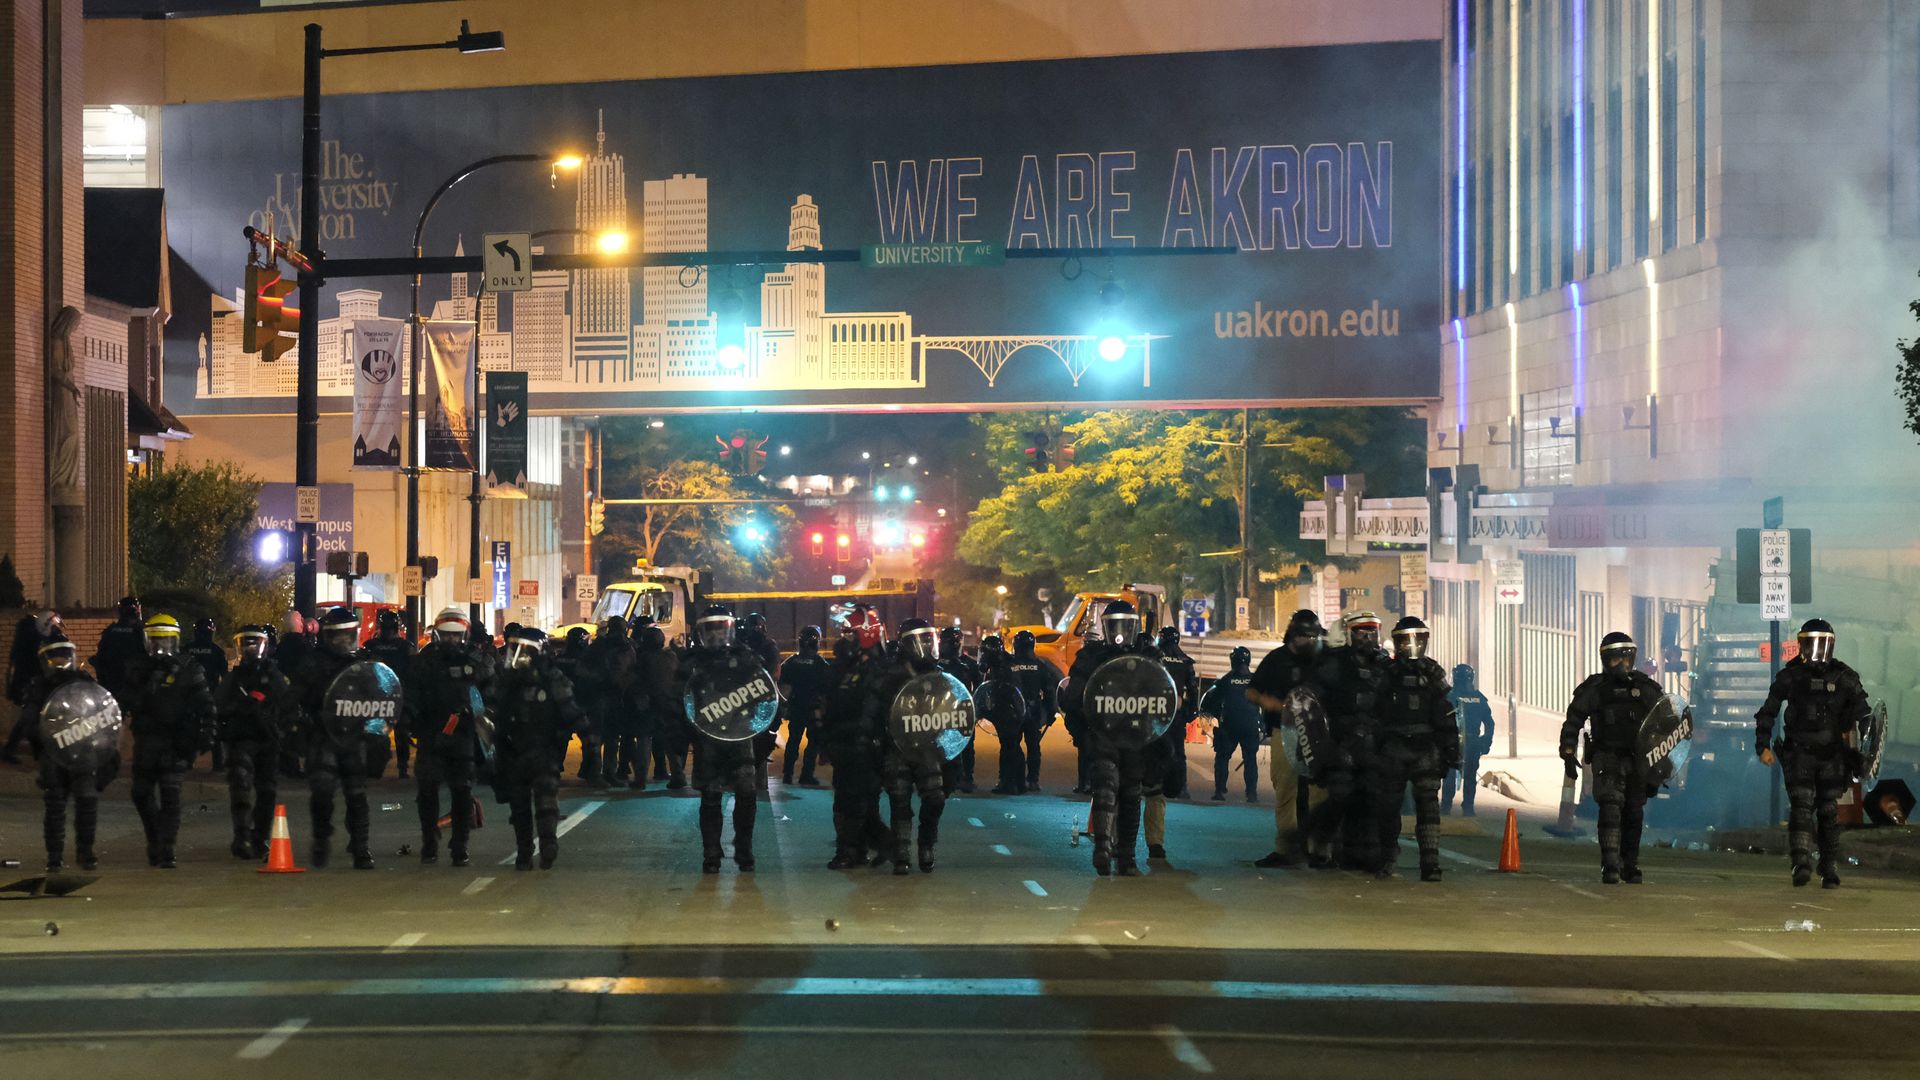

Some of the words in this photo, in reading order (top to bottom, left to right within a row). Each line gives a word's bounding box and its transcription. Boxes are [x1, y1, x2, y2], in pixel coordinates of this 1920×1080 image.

[872, 157, 982, 243] WE
[1007, 151, 1135, 248] ARE
[1161, 141, 1393, 250] AKRON
[875, 246, 965, 264] UNIVERSITY
[975, 245, 992, 255] AVE
[492, 277, 525, 286] ONLY
[1214, 300, 1400, 339] uakron.edu
[258, 516, 293, 532] West
[316, 520, 353, 534] mpus
[1763, 536, 1786, 545] POLICE
[1766, 548, 1785, 556] CARS
[495, 542, 507, 609] ENTER
[578, 588, 594, 599] 25
[1767, 582, 1784, 591] TOW
[1765, 593, 1786, 602] AWAY
[1185, 601, 1204, 613] 76
[1765, 605, 1786, 614] ZONE
[335, 699, 396, 717] TROOPER
[700, 678, 770, 723] TROOPER
[1094, 695, 1168, 715] TROOPER
[52, 703, 116, 749] TROOPER
[901, 709, 968, 733] TROOPER
[1645, 718, 1690, 768] TROOPER
